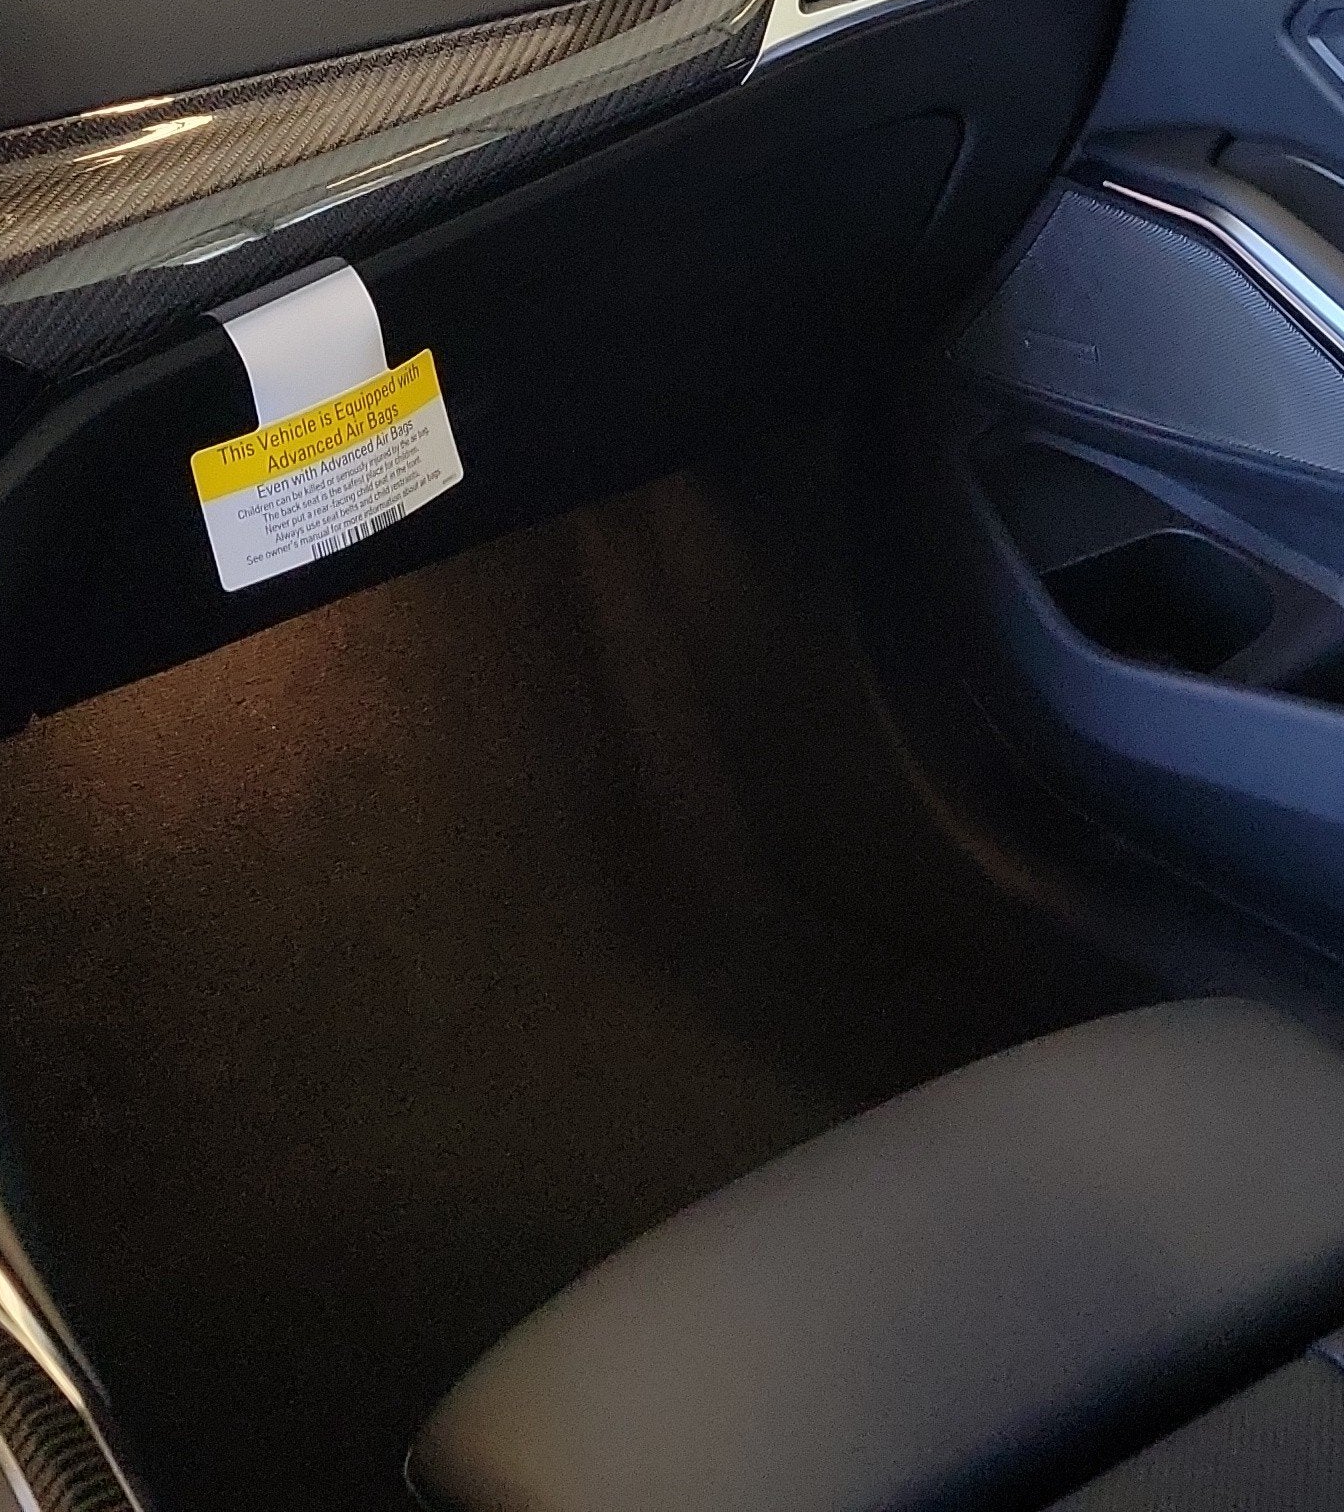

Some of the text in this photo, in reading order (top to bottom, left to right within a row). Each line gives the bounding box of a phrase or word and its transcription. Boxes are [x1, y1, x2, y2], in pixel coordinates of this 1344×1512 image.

[217, 363, 421, 466] This Vehicle is Equipped with
[267, 403, 400, 473] Advanced Air Bags
[256, 419, 414, 499] Even with Advanced Air Bags
[237, 501, 275, 520] Children
[275, 494, 292, 506] can
[304, 480, 326, 496] killed
[326, 476, 335, 486] or
[337, 461, 368, 480] seriously
[262, 510, 280, 523] The
[280, 504, 302, 519] back
[302, 496, 320, 509] seat
[321, 492, 329, 501] is
[328, 487, 343, 499] the
[343, 474, 365, 491] safest
[265, 520, 290, 536] Never
[291, 513, 305, 525] put
[307, 511, 313, 519] a
[313, 492, 357, 517] rear-facing
[357, 483, 374, 497] child
[246, 554, 264, 566] See
[265, 540, 299, 559] owner's
[299, 527, 330, 547] manual
[331, 521, 343, 533] for
[343, 514, 363, 526] more
[275, 526, 305, 544] Always
[306, 520, 321, 531] use
[322, 509, 339, 523] seat
[340, 502, 359, 517] belts
[359, 495, 374, 508] and
